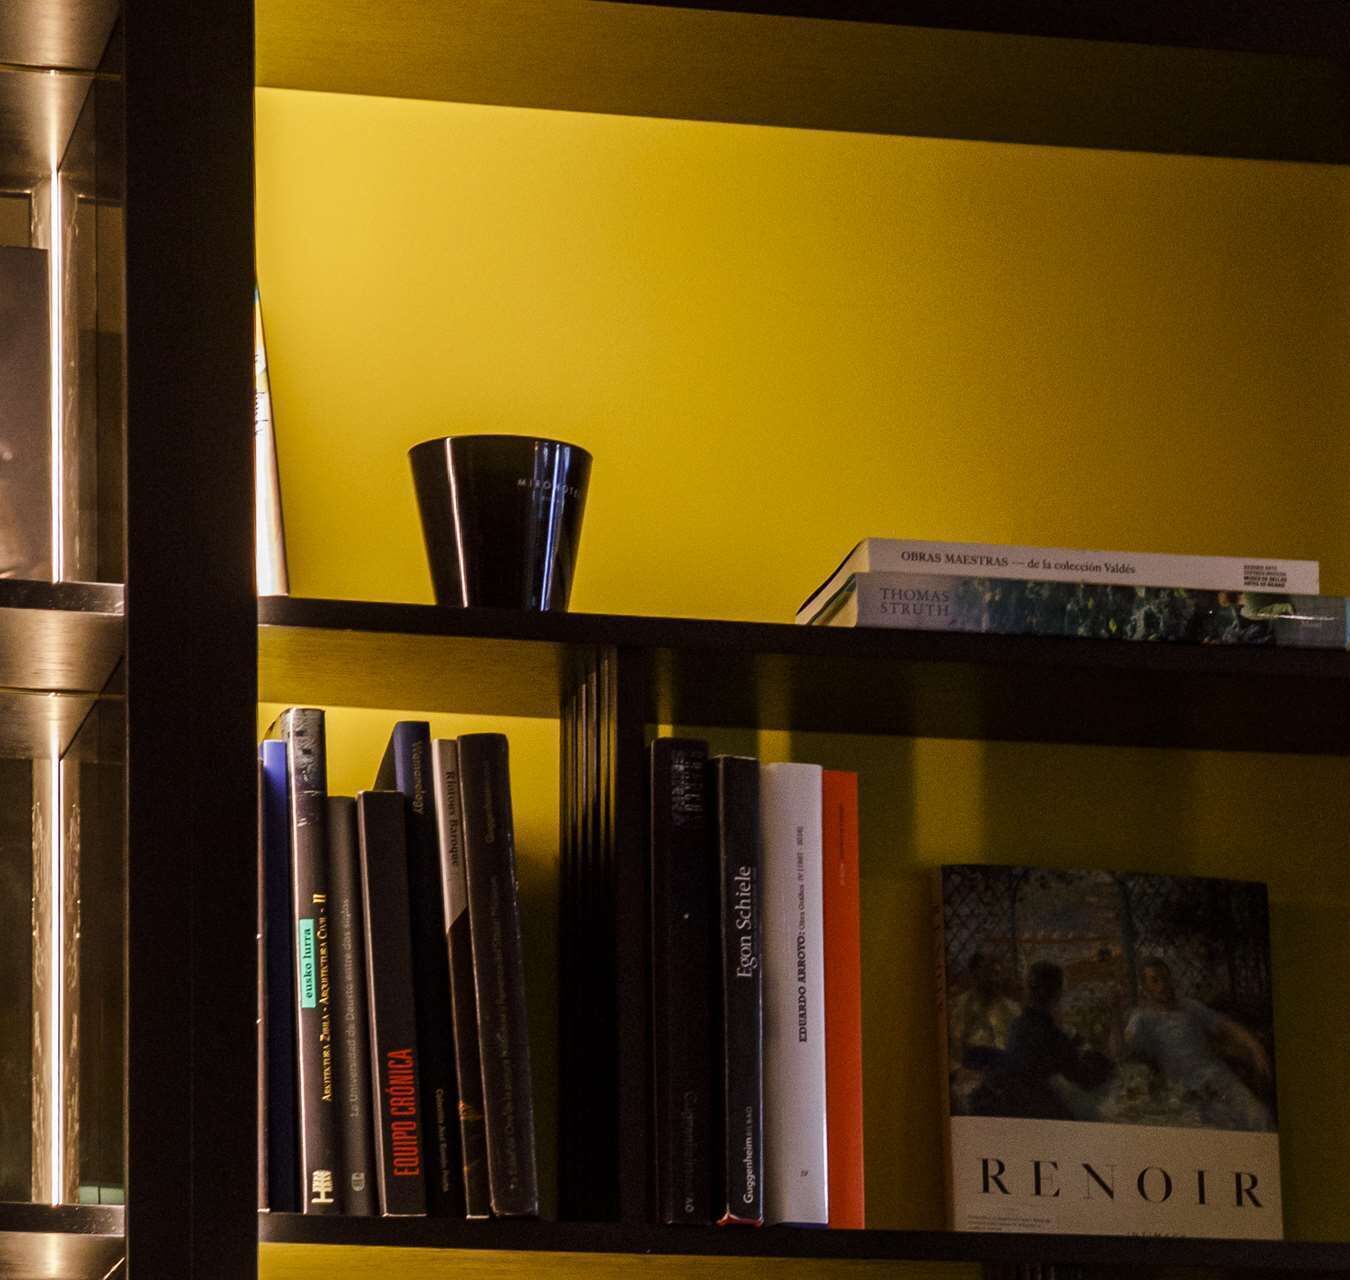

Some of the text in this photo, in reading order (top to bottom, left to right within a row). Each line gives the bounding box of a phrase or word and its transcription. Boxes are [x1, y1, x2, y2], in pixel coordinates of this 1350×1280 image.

[879, 587, 950, 604] THOMAS
[900, 550, 1136, 574] OBRAS MAESTRAS de la colección Valdés
[879, 600, 950, 619] STRUTH
[445, 770, 461, 865] Riotous Baroque
[734, 865, 757, 976] Egon Schiele
[302, 928, 312, 998] eusko lurra
[797, 930, 807, 1041] EDUARDO ARROYO:
[341, 898, 358, 1116] La Universidad de Deusto entre dos siglos
[386, 1048, 419, 1176] EQUIPO CRÓNICA
[742, 1136, 756, 1203] Guggenheim
[976, 1157, 1264, 1208] RENOIR
